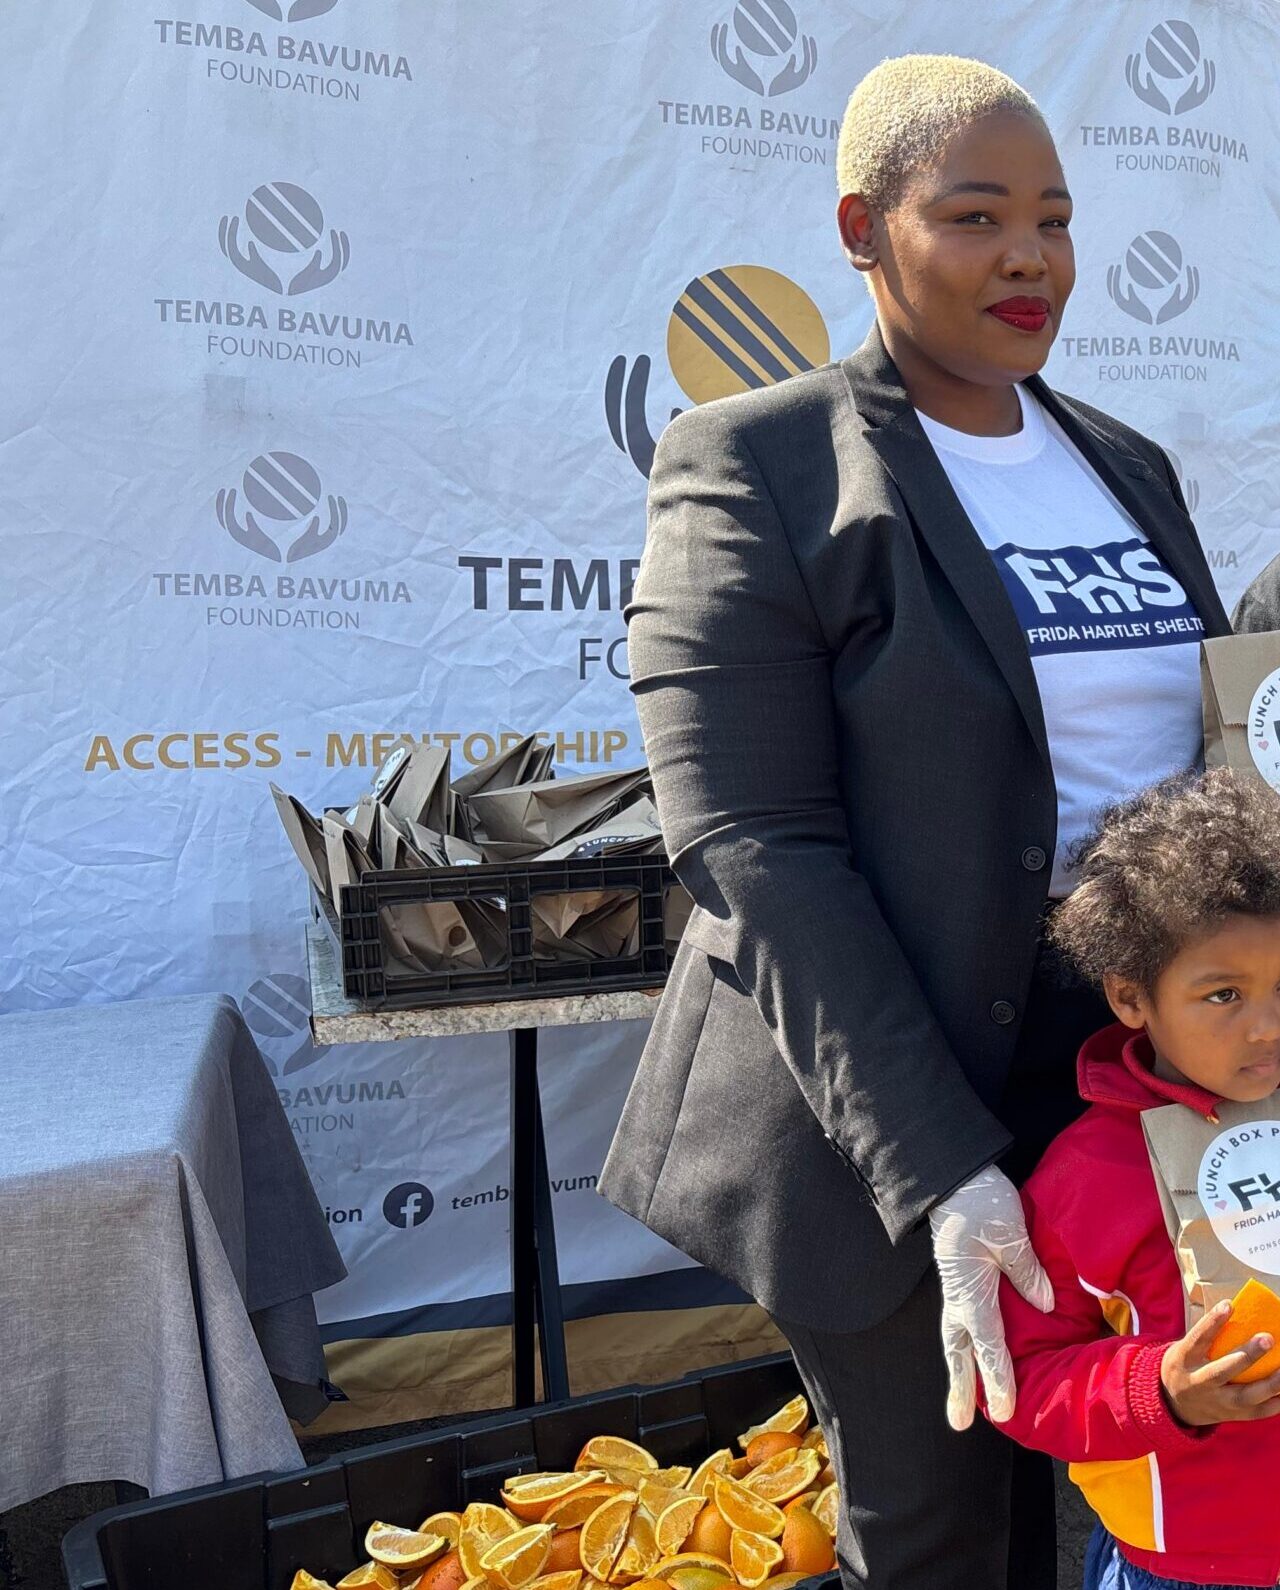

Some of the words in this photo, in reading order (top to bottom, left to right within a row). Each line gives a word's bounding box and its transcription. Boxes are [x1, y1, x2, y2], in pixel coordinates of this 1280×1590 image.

[154, 19, 268, 57] TEMBA
[277, 36, 413, 81] BAVUMA
[207, 58, 360, 101] FOUNDATION
[658, 100, 752, 129] TEMBA
[760, 109, 841, 140] BAVU
[701, 135, 826, 165] FOUNDATION
[1080, 125, 1160, 146] TEMBA
[1166, 126, 1249, 162] BAVUMA
[1115, 154, 1221, 178] FOUNDATION
[154, 298, 268, 329] TEMBA
[278, 308, 414, 346] BAVUMA
[207, 335, 361, 368] FOUNDATION
[1061, 337, 1142, 357] TEMBA
[1149, 336, 1241, 361] BAVUMA
[1099, 364, 1207, 382] FOUNDATION
[153, 573, 267, 598] TEMBA
[277, 576, 413, 603] BAVUMA
[458, 556, 641, 612] TEM
[1004, 547, 1187, 615] FHS
[207, 607, 360, 629] FOUNDATION
[1026, 626, 1078, 645] FRIDA
[1083, 621, 1151, 640] HARTLEY
[1254, 685, 1278, 738] LUNCH
[84, 733, 282, 771] ACCESS
[1206, 1147, 1229, 1199] LUNCH
[1229, 1128, 1263, 1148] BOX
[1233, 1216, 1266, 1231] FRIDA
